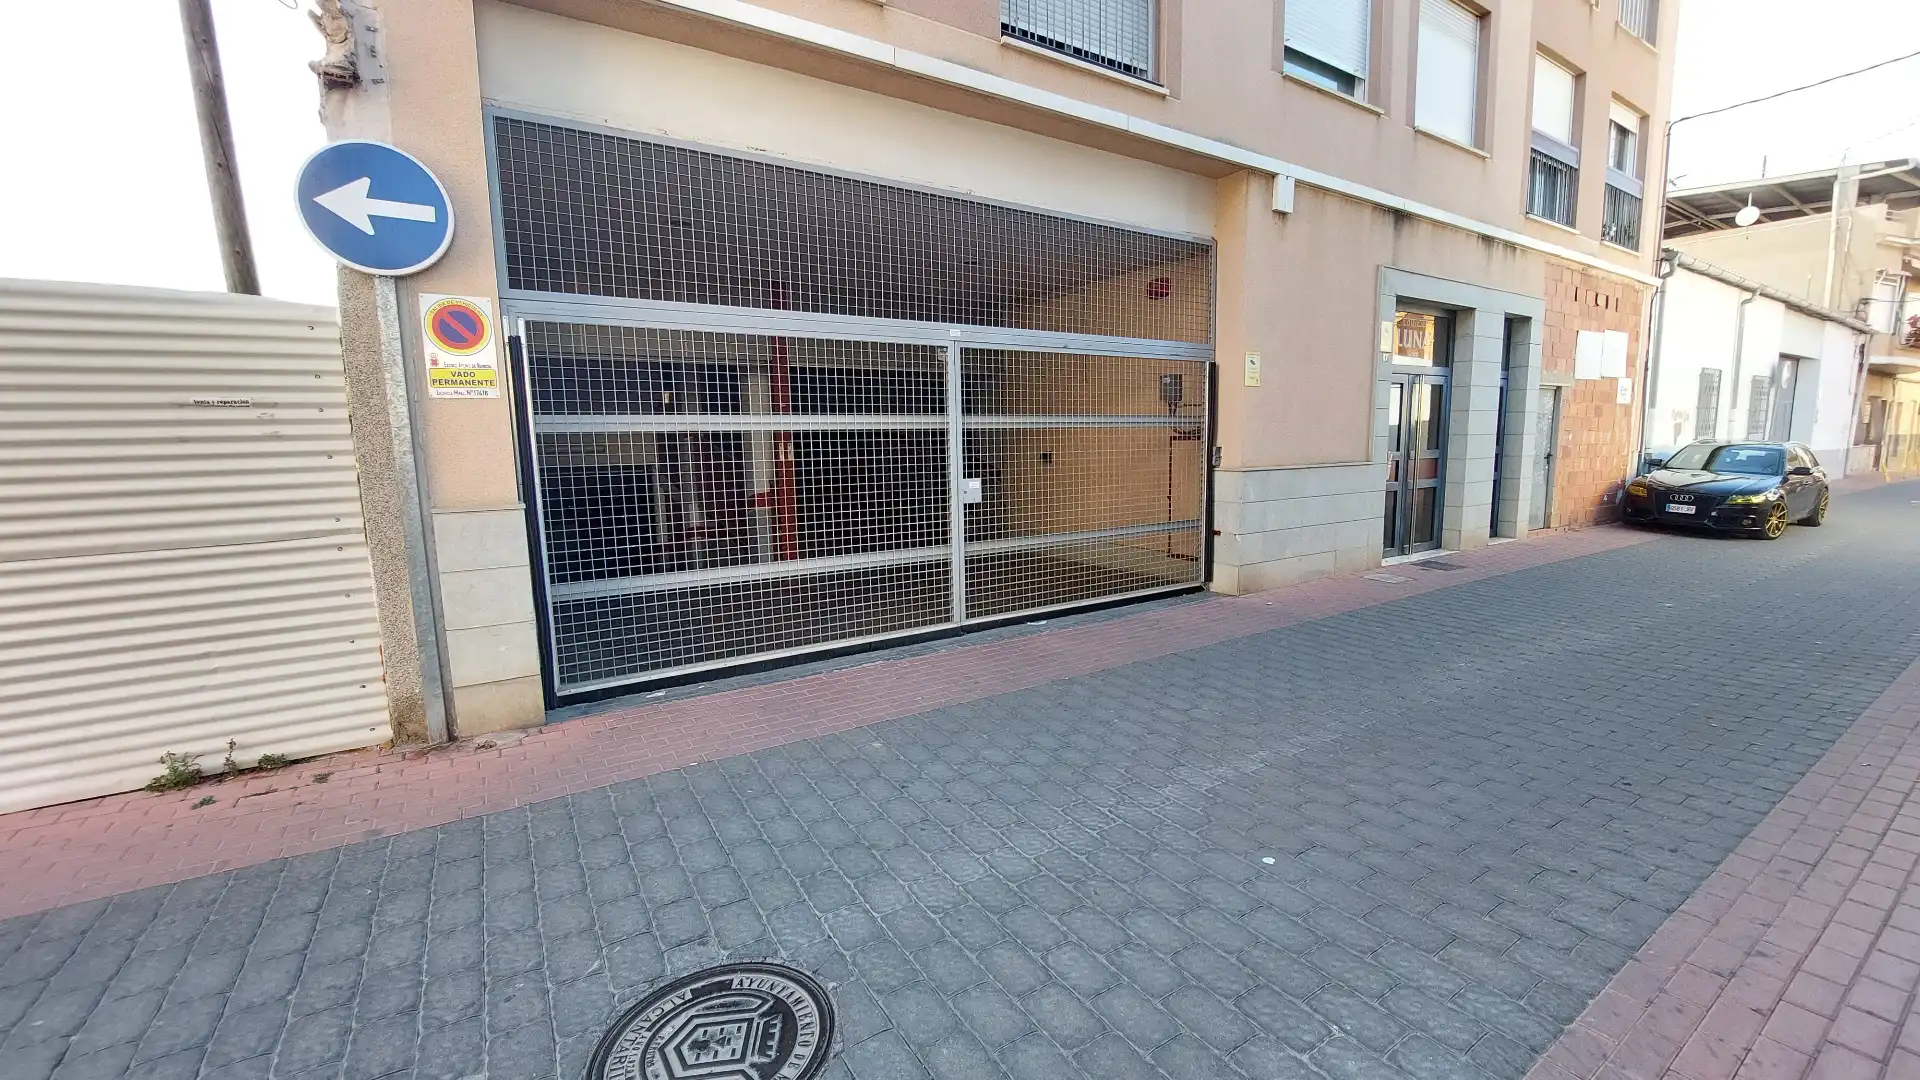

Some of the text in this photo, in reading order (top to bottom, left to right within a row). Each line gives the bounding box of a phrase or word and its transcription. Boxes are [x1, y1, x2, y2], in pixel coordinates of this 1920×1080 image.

[432, 379, 496, 387] PERMANENTE
[735, 978, 815, 1069] AYUNTAMIENTO DE
